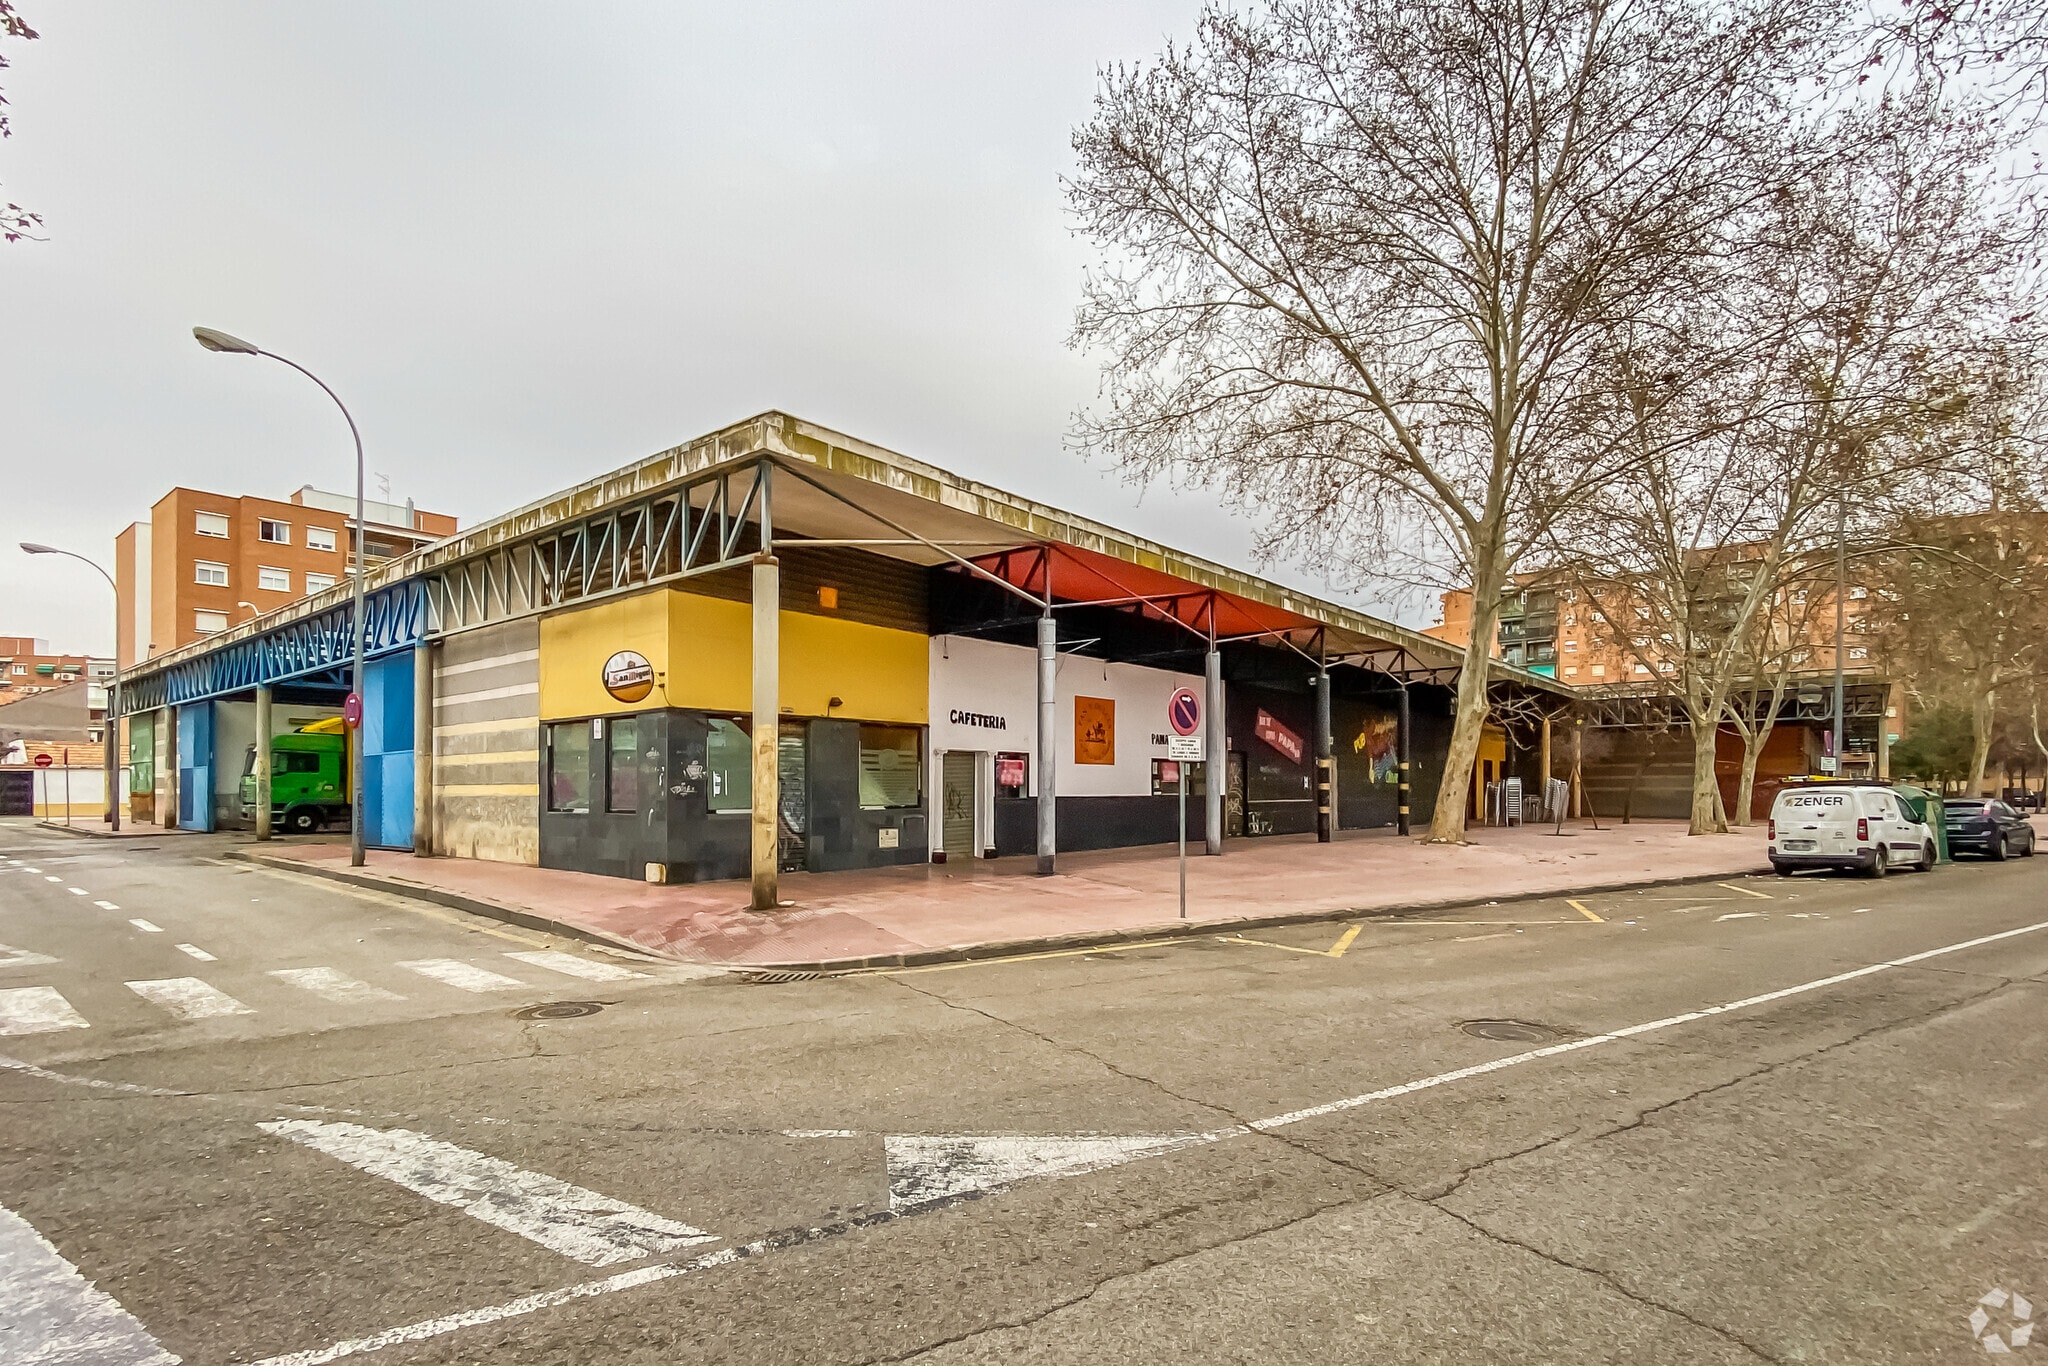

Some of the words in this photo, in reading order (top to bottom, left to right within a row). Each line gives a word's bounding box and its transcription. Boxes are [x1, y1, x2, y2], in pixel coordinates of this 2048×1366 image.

[950, 709, 1006, 730] CAFETERIA
[1151, 733, 1169, 746] PANA
[1794, 796, 1844, 807] ZENER
